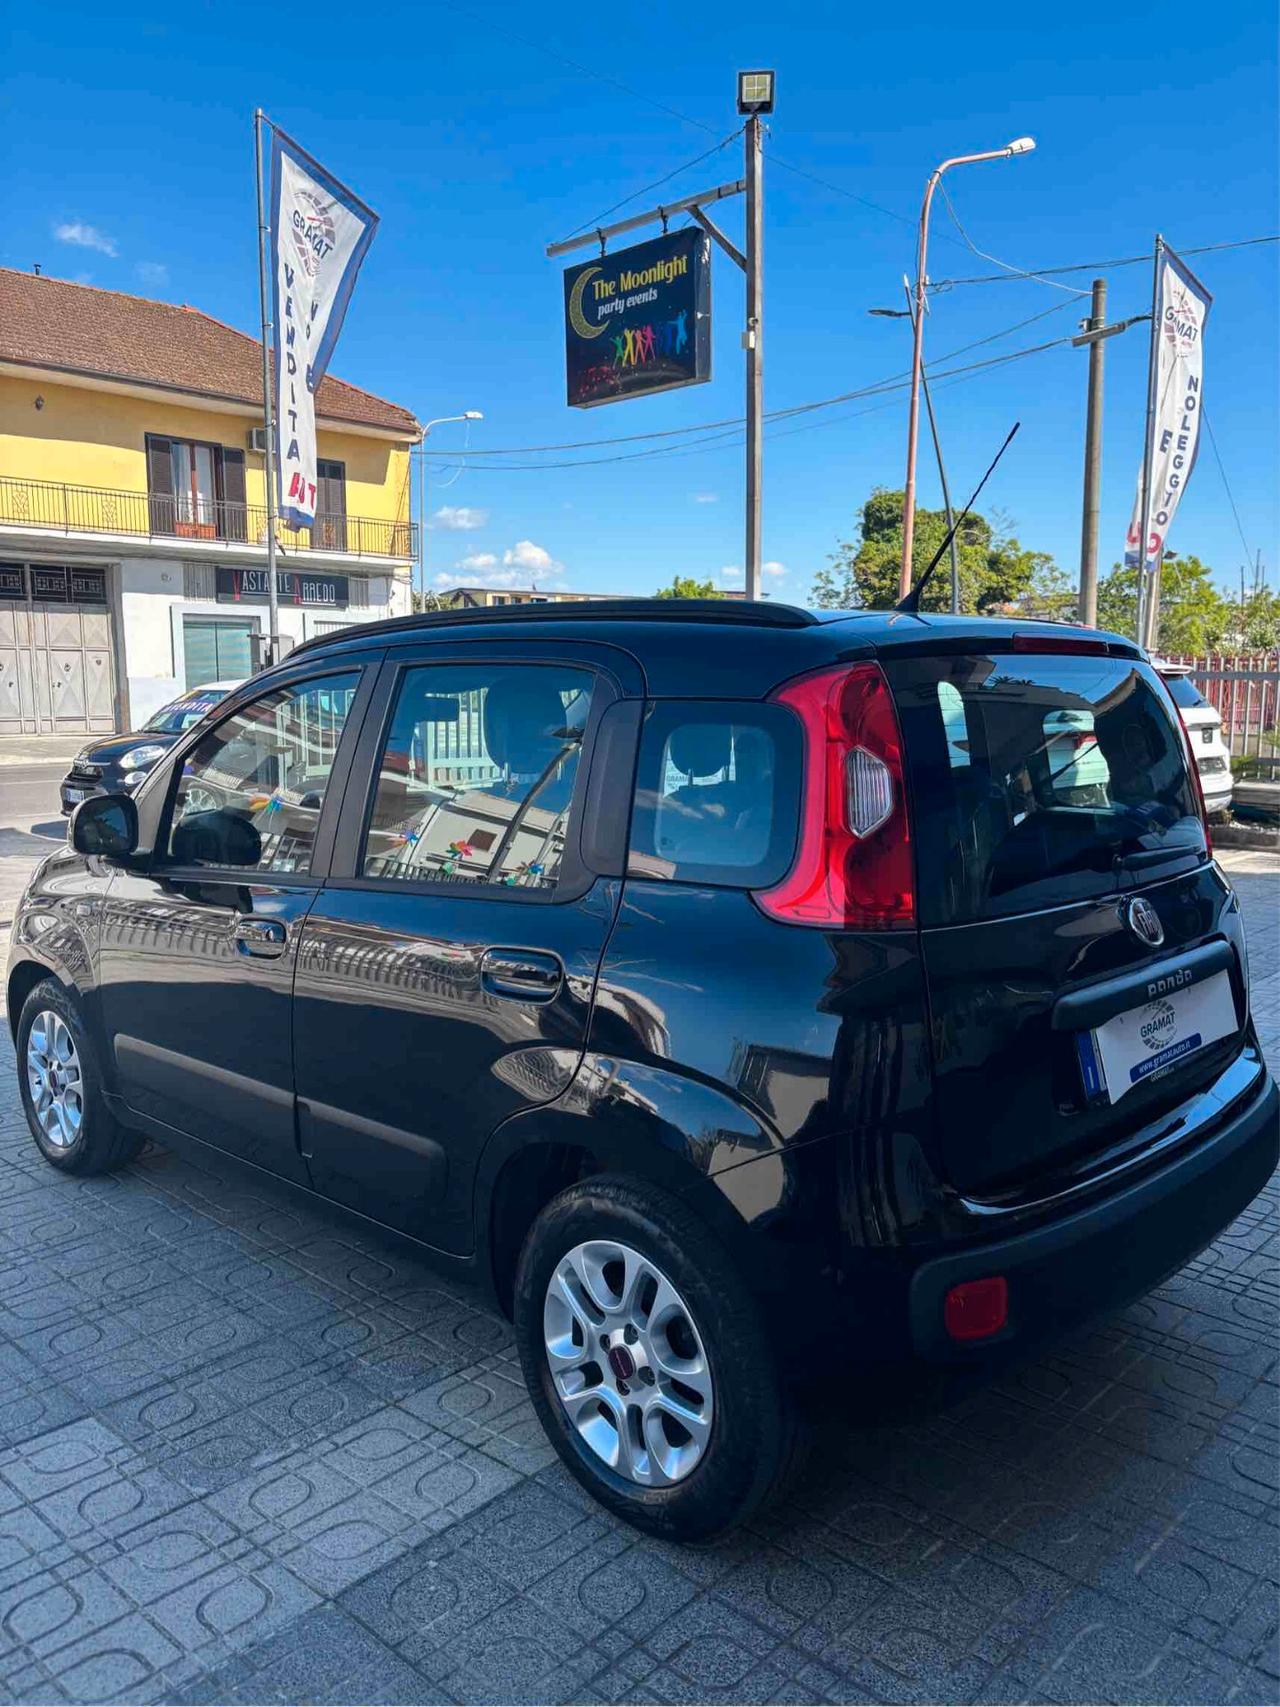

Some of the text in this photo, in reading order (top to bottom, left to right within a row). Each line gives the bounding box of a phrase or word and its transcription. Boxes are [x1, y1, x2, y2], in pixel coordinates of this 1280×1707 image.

[593, 255, 688, 301] The Moonlight
[597, 287, 658, 321] party events
[284, 262, 301, 461] VENDITA
[1155, 375, 1199, 526] NOLEGGIO
[232, 568, 291, 601] VASTATE
[1140, 1011, 1176, 1038] GRAMAT
